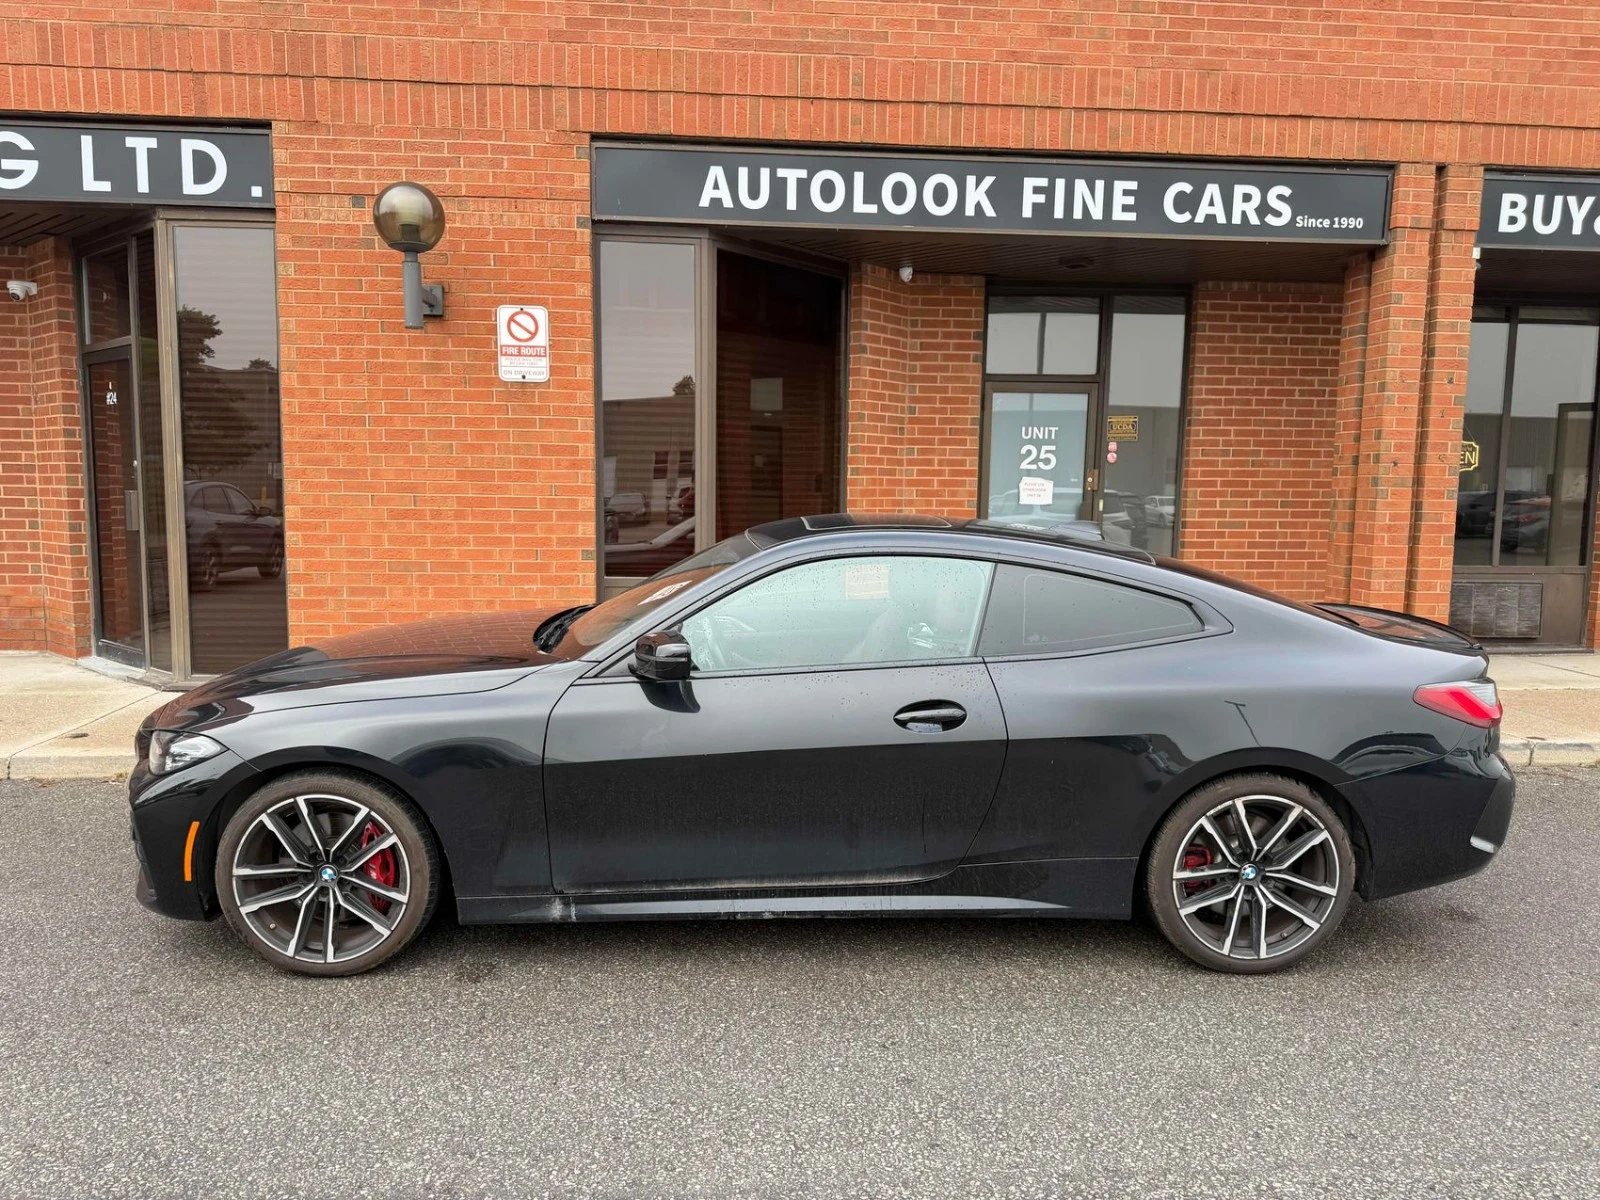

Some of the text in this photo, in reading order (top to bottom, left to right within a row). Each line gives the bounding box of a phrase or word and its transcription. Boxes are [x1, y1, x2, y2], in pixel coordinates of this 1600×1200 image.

[80, 135, 263, 198] LTD.
[698, 165, 1364, 230] AUTOLOOK FINE CARS Since 1990
[1497, 192, 1600, 237] BUY
[502, 346, 546, 357] FIRE ROUTE
[106, 391, 117, 405] #24
[1021, 426, 1059, 440] UNIT
[1019, 444, 1057, 471] 25
